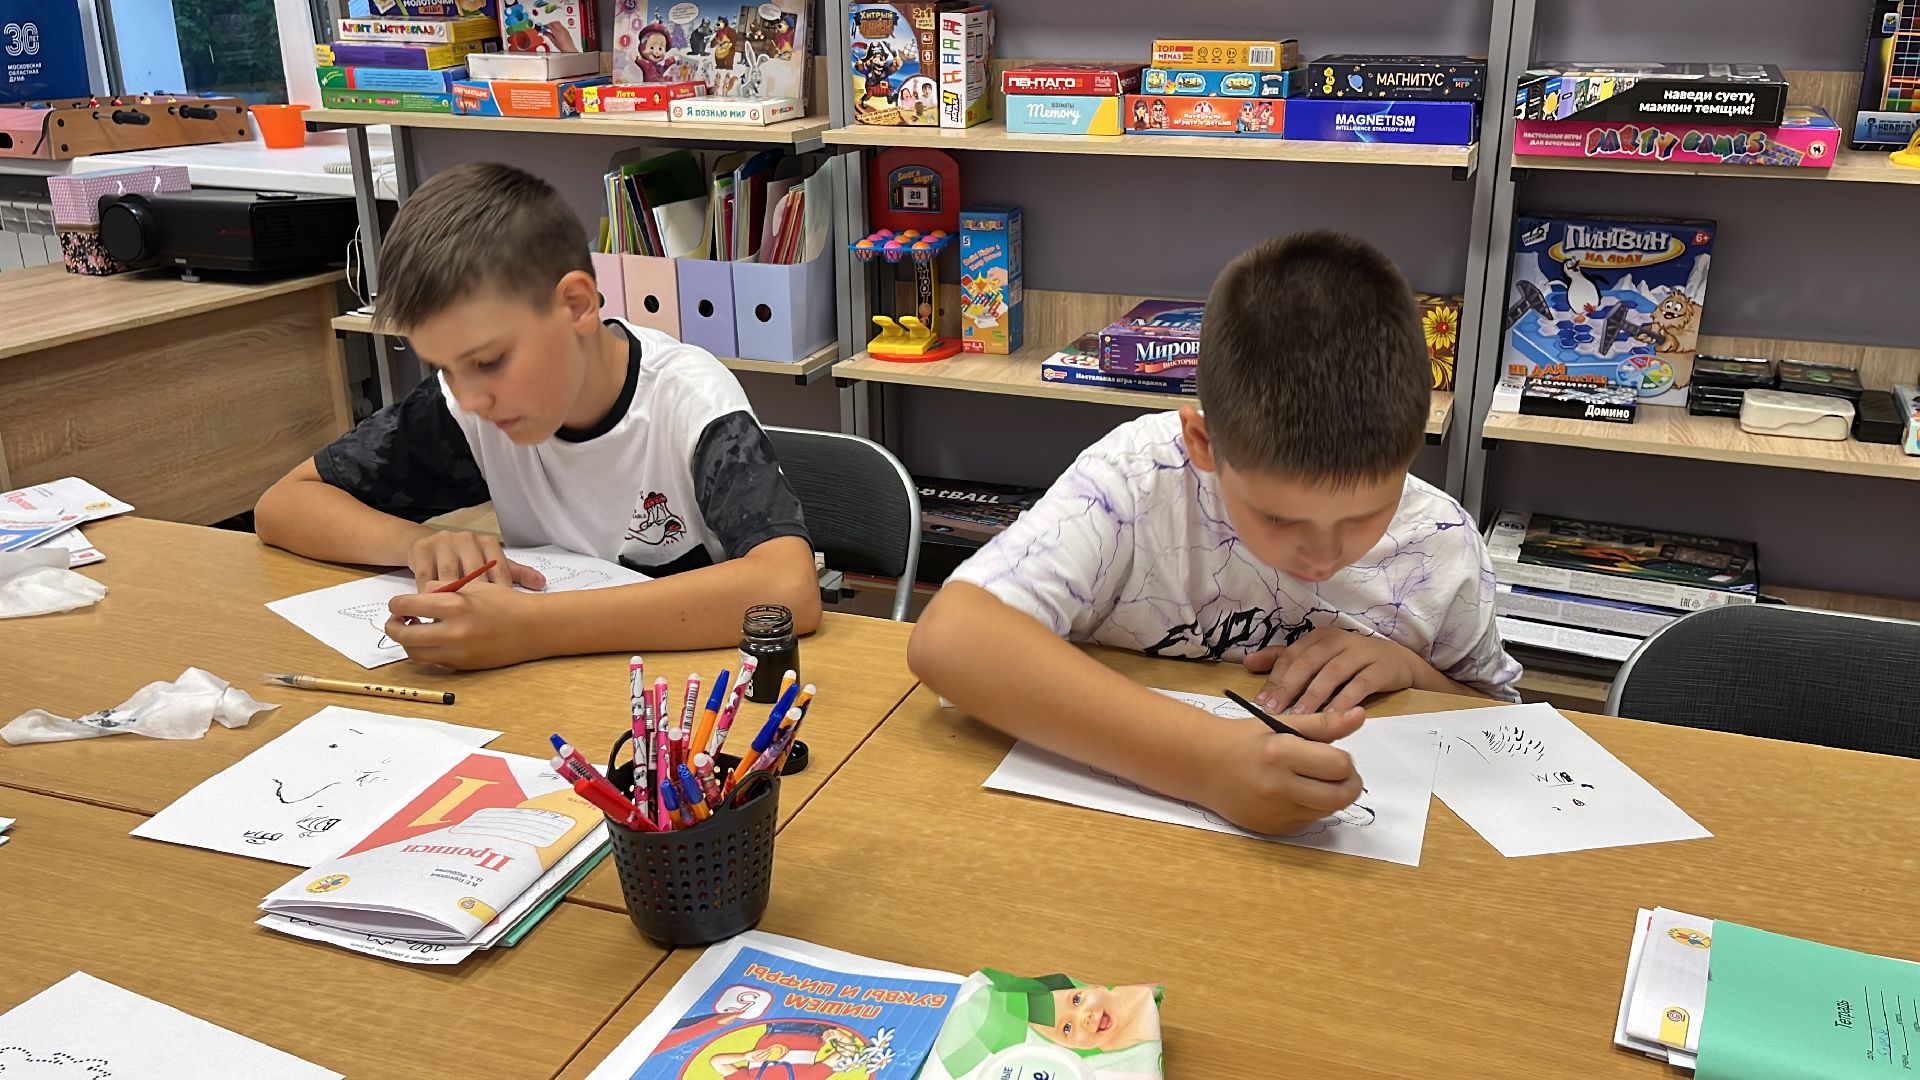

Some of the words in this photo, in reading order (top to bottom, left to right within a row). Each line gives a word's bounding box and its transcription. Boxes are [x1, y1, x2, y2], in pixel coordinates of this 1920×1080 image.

[860, 11, 893, 20] ХИТРЫЙ
[4, 22, 40, 56] 30
[1008, 77, 1076, 87] ПЕНТАГО
[1376, 72, 1445, 87] МАГНИТУС
[1663, 89, 1713, 101] наведи
[1714, 91, 1756, 104] суету,
[1026, 103, 1082, 126] Memory
[1639, 102, 1692, 114] мамкин
[1696, 103, 1755, 116] темщик!
[1335, 113, 1416, 127] MAGNETISM
[1585, 124, 1680, 161] PARTY
[1682, 128, 1767, 161] GAMES
[1565, 224, 1669, 251] ПИНГВИН
[1695, 233, 1711, 243] 6+
[1585, 252, 1605, 263] НА
[1585, 404, 1630, 419] Домино
[400, 842, 515, 872] Прописи
[743, 963, 837, 998] ЦИФРЫ
[839, 984, 860, 999] И
[861, 987, 948, 1009] БУКВЫ
[782, 991, 884, 1020] ПИШЕМ
[1834, 999, 1855, 1030] Тетрадь
